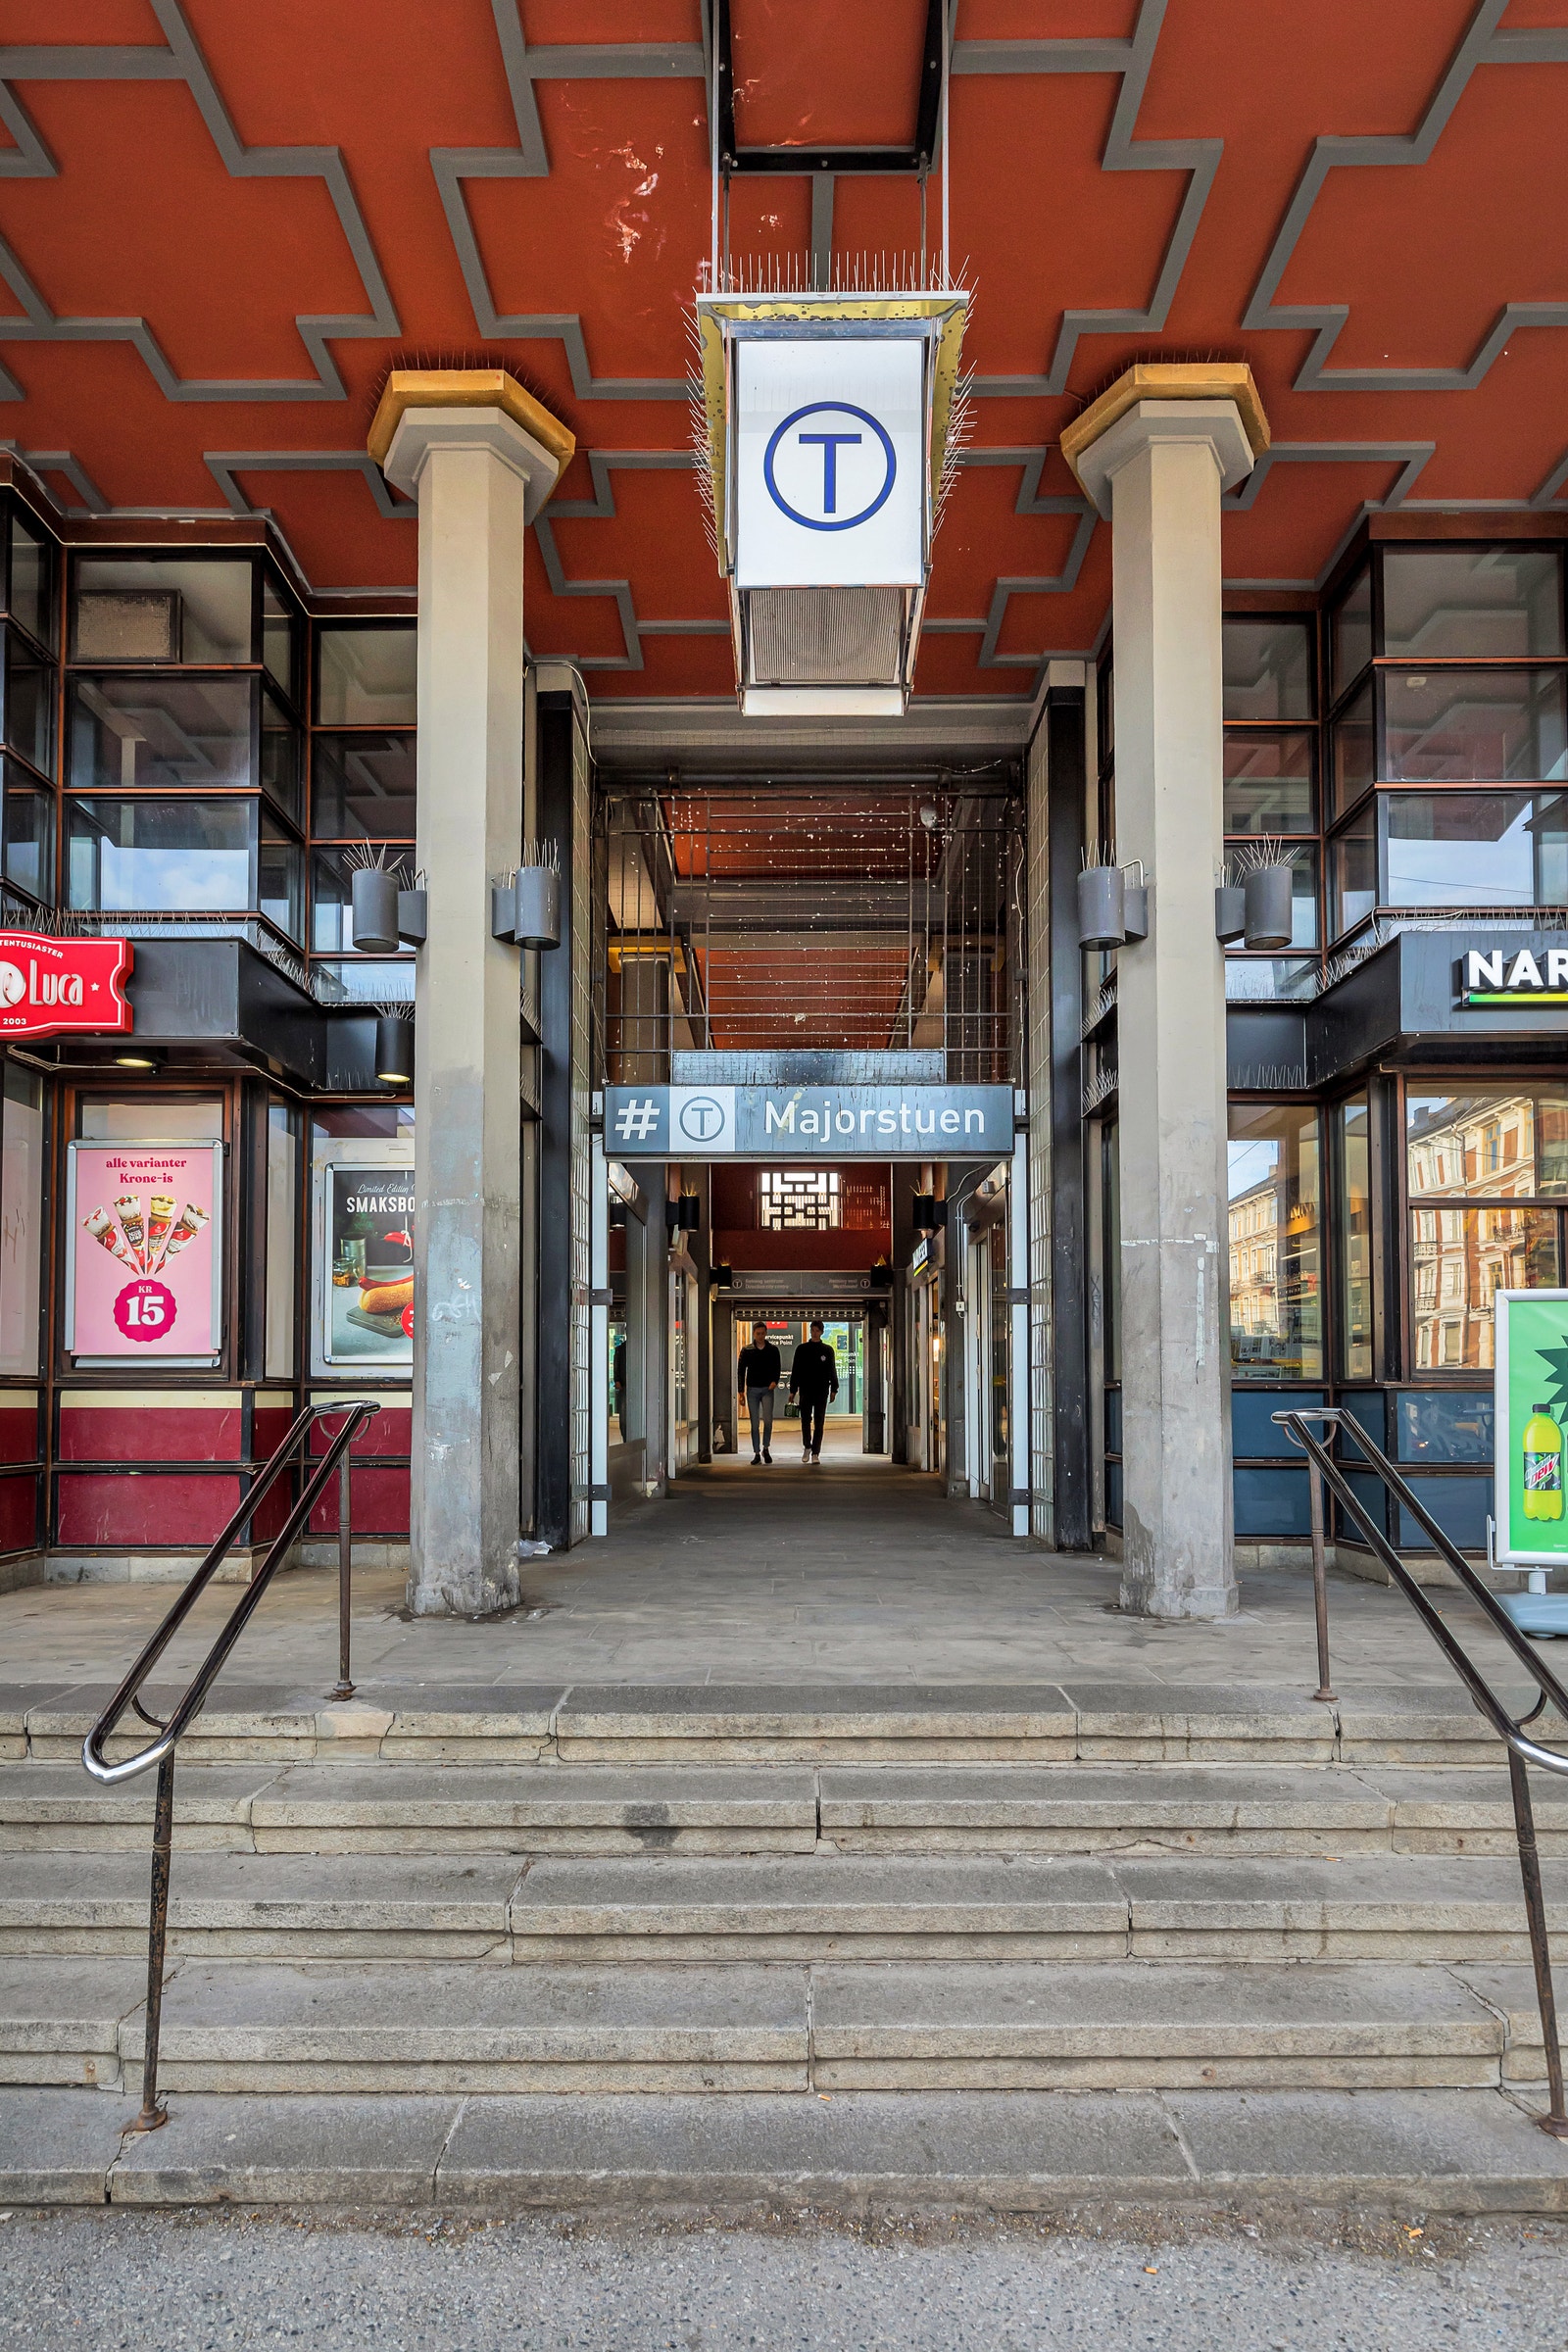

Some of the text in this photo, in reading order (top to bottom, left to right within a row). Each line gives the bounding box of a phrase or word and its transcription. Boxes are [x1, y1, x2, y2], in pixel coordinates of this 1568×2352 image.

[28, 958, 83, 1006] Luca
[3, 1017, 27, 1026] 2003
[764, 1101, 985, 1144] Majorstuen
[106, 1157, 187, 1168] alle varianter
[119, 1173, 173, 1184] Krone-is
[357, 1183, 385, 1195] Limited
[386, 1183, 410, 1195] Edition
[138, 1285, 153, 1294] KR
[125, 1296, 166, 1326] 15
